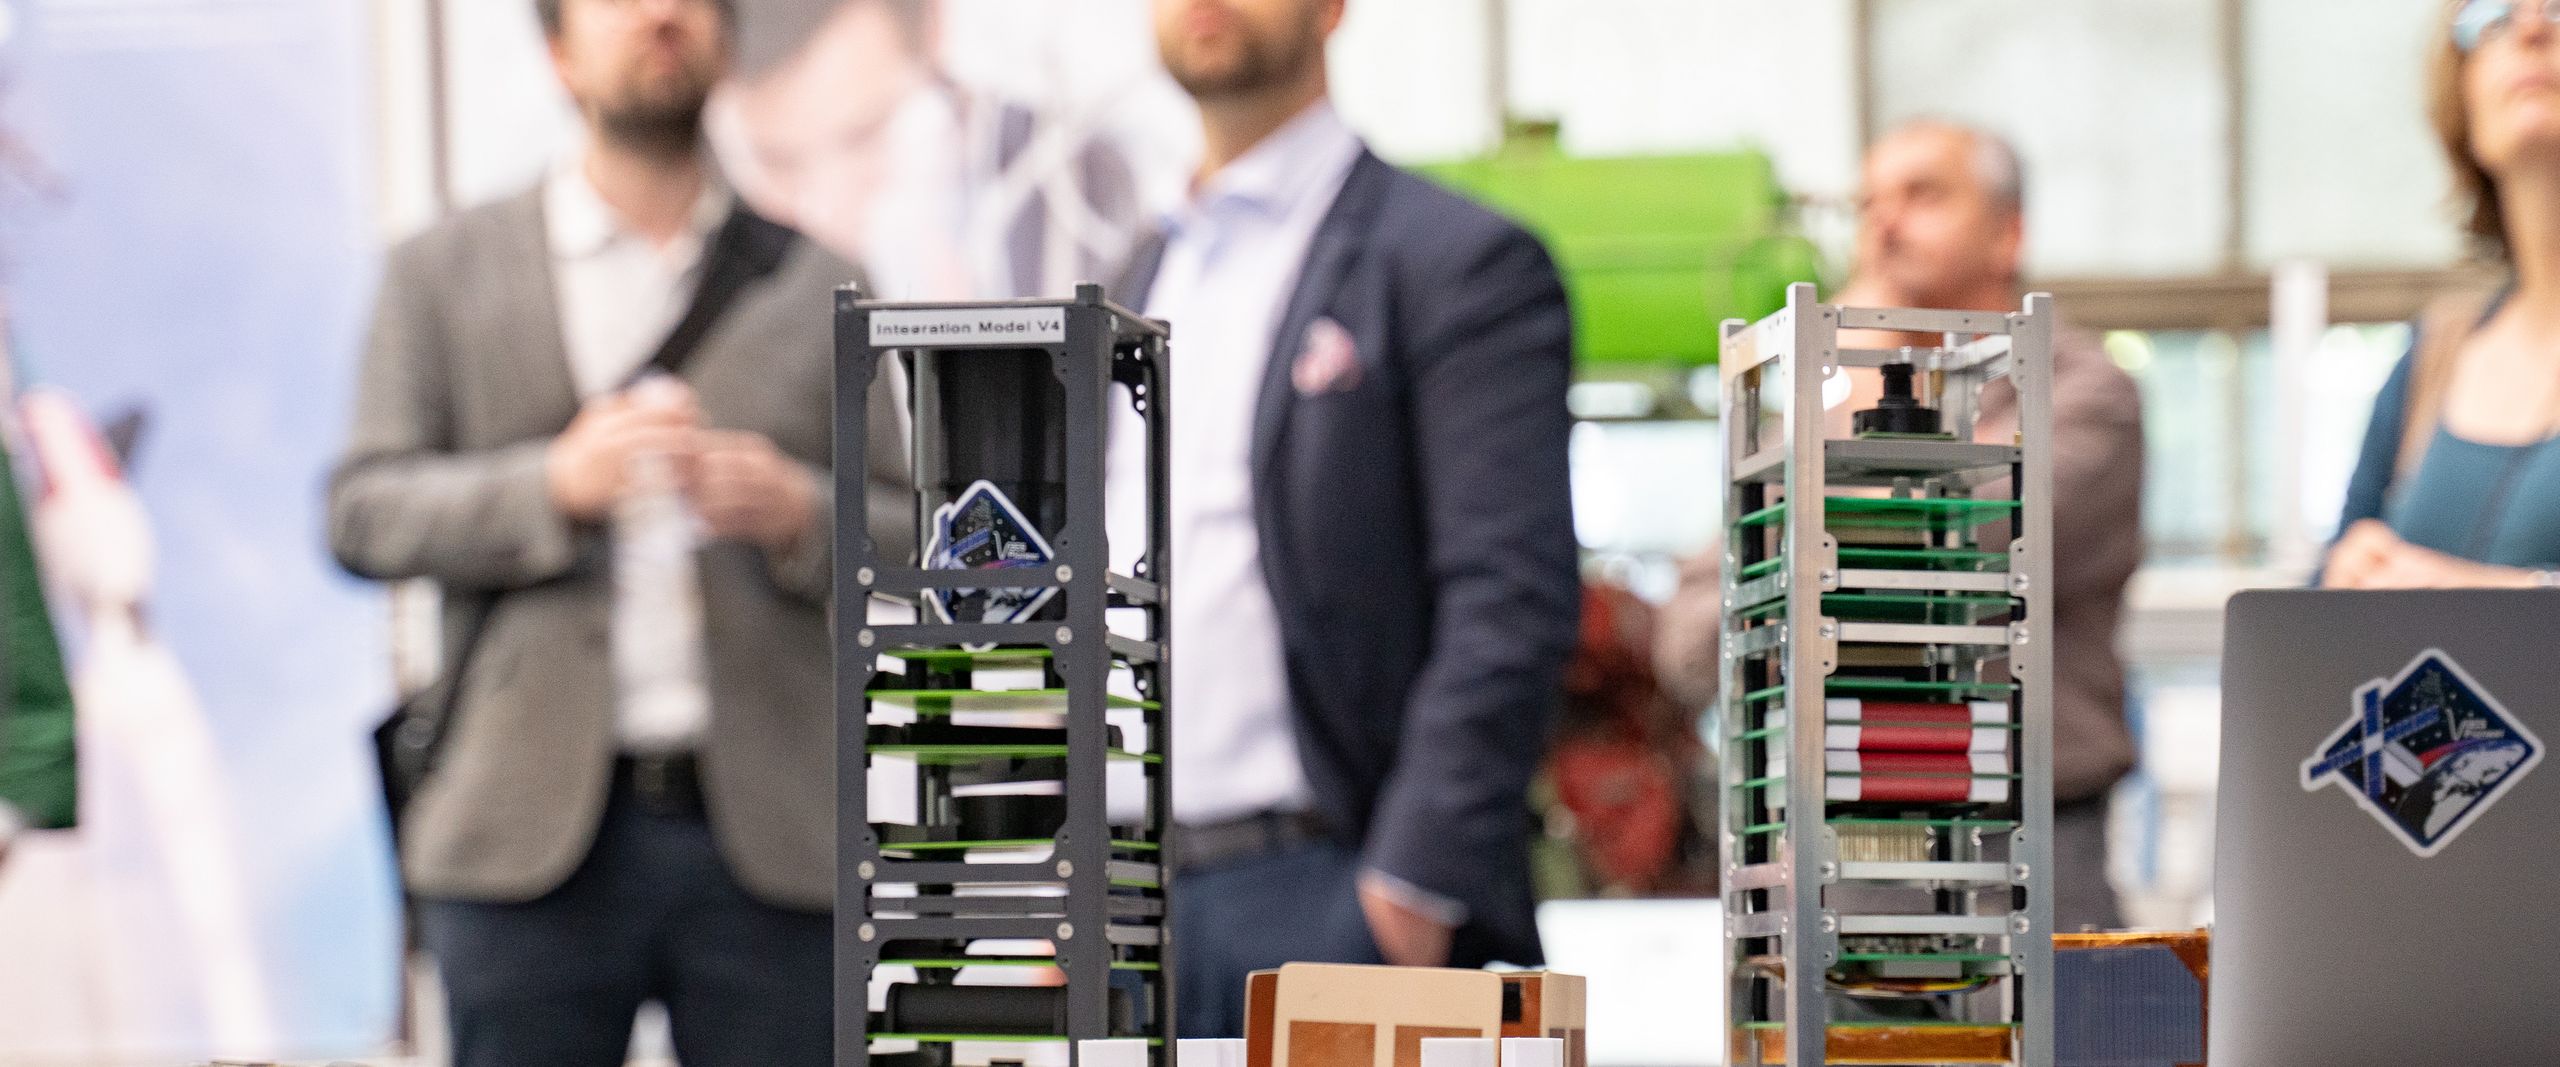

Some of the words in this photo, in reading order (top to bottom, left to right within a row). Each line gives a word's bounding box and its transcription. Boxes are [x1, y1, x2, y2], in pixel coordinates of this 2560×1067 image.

[876, 322, 971, 335] Integration
[978, 321, 1031, 333] Model
[1037, 320, 1060, 332] V4
